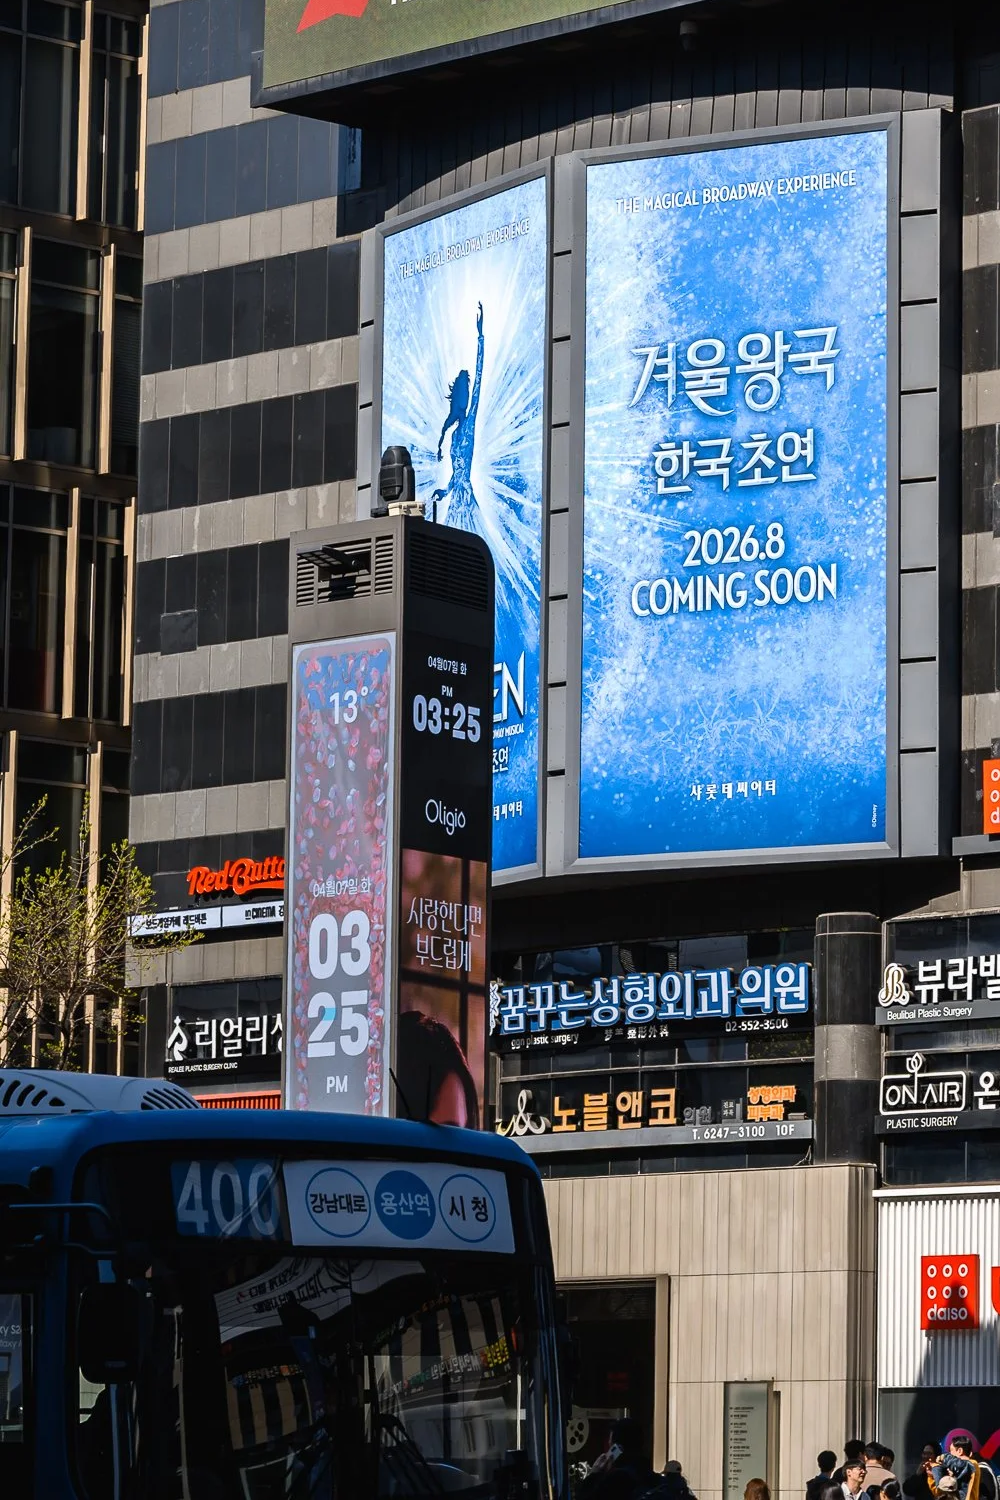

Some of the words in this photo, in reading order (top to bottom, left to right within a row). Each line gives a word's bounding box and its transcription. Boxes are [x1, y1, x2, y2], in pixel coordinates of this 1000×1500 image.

[616, 196, 640, 214] THE
[643, 190, 699, 211] MAGICAL
[702, 180, 775, 204] BROADWAY
[777, 169, 857, 195] EXPERIENCE
[399, 260, 414, 279] THE
[415, 250, 445, 275] MAGICAL
[446, 235, 486, 263] BROADWAY
[486, 217, 530, 249] EXPERIENCE
[629, 326, 842, 418] 겨울왕국
[682, 522, 786, 567] 2026.8
[631, 571, 748, 617] COMING
[753, 563, 837, 608] SOON
[428, 655, 458, 675] 04월07일
[460, 661, 468, 676] 화
[441, 685, 453, 697] PM
[330, 686, 369, 726] 13°
[413, 694, 481, 743] 03:25
[505, 723, 525, 738] MUSICAL
[426, 799, 466, 836] Oligio
[313, 879, 358, 898] 04월07일
[361, 877, 372, 894] 화
[407, 896, 482, 938] 사랑한다면
[309, 909, 371, 980] 03
[416, 933, 471, 972] 부드럽게
[308, 990, 370, 1058] 25
[725, 1019, 789, 1032] 02-552-3500
[887, 1009, 916, 1021] Beulibal
[917, 1007, 942, 1019] Plastic
[943, 1005, 973, 1018] Surgery
[526, 1033, 549, 1048] plastic
[550, 1033, 579, 1046] surgery
[168, 1065, 185, 1074] REALEE
[185, 1064, 203, 1073] PLASTIC
[203, 1062, 223, 1071] SURGERY
[223, 1061, 238, 1069] CLINIC
[326, 1075, 347, 1093] PM
[747, 1085, 796, 1103] 성형외과
[886, 1085, 917, 1106] ON
[924, 1081, 961, 1104] AIR
[552, 1087, 677, 1132] 노블앤코
[747, 1104, 784, 1122] 피부과
[703, 1125, 765, 1139] 6247-3100
[776, 1124, 795, 1137] 10F
[886, 1117, 919, 1130] PLASTIC
[920, 1115, 959, 1128] SURGERY
[178, 1160, 280, 1236] 400
[310, 1192, 368, 1214] 강남대로
[381, 1191, 431, 1217] 용산역
[927, 1304, 968, 1322] daiso
